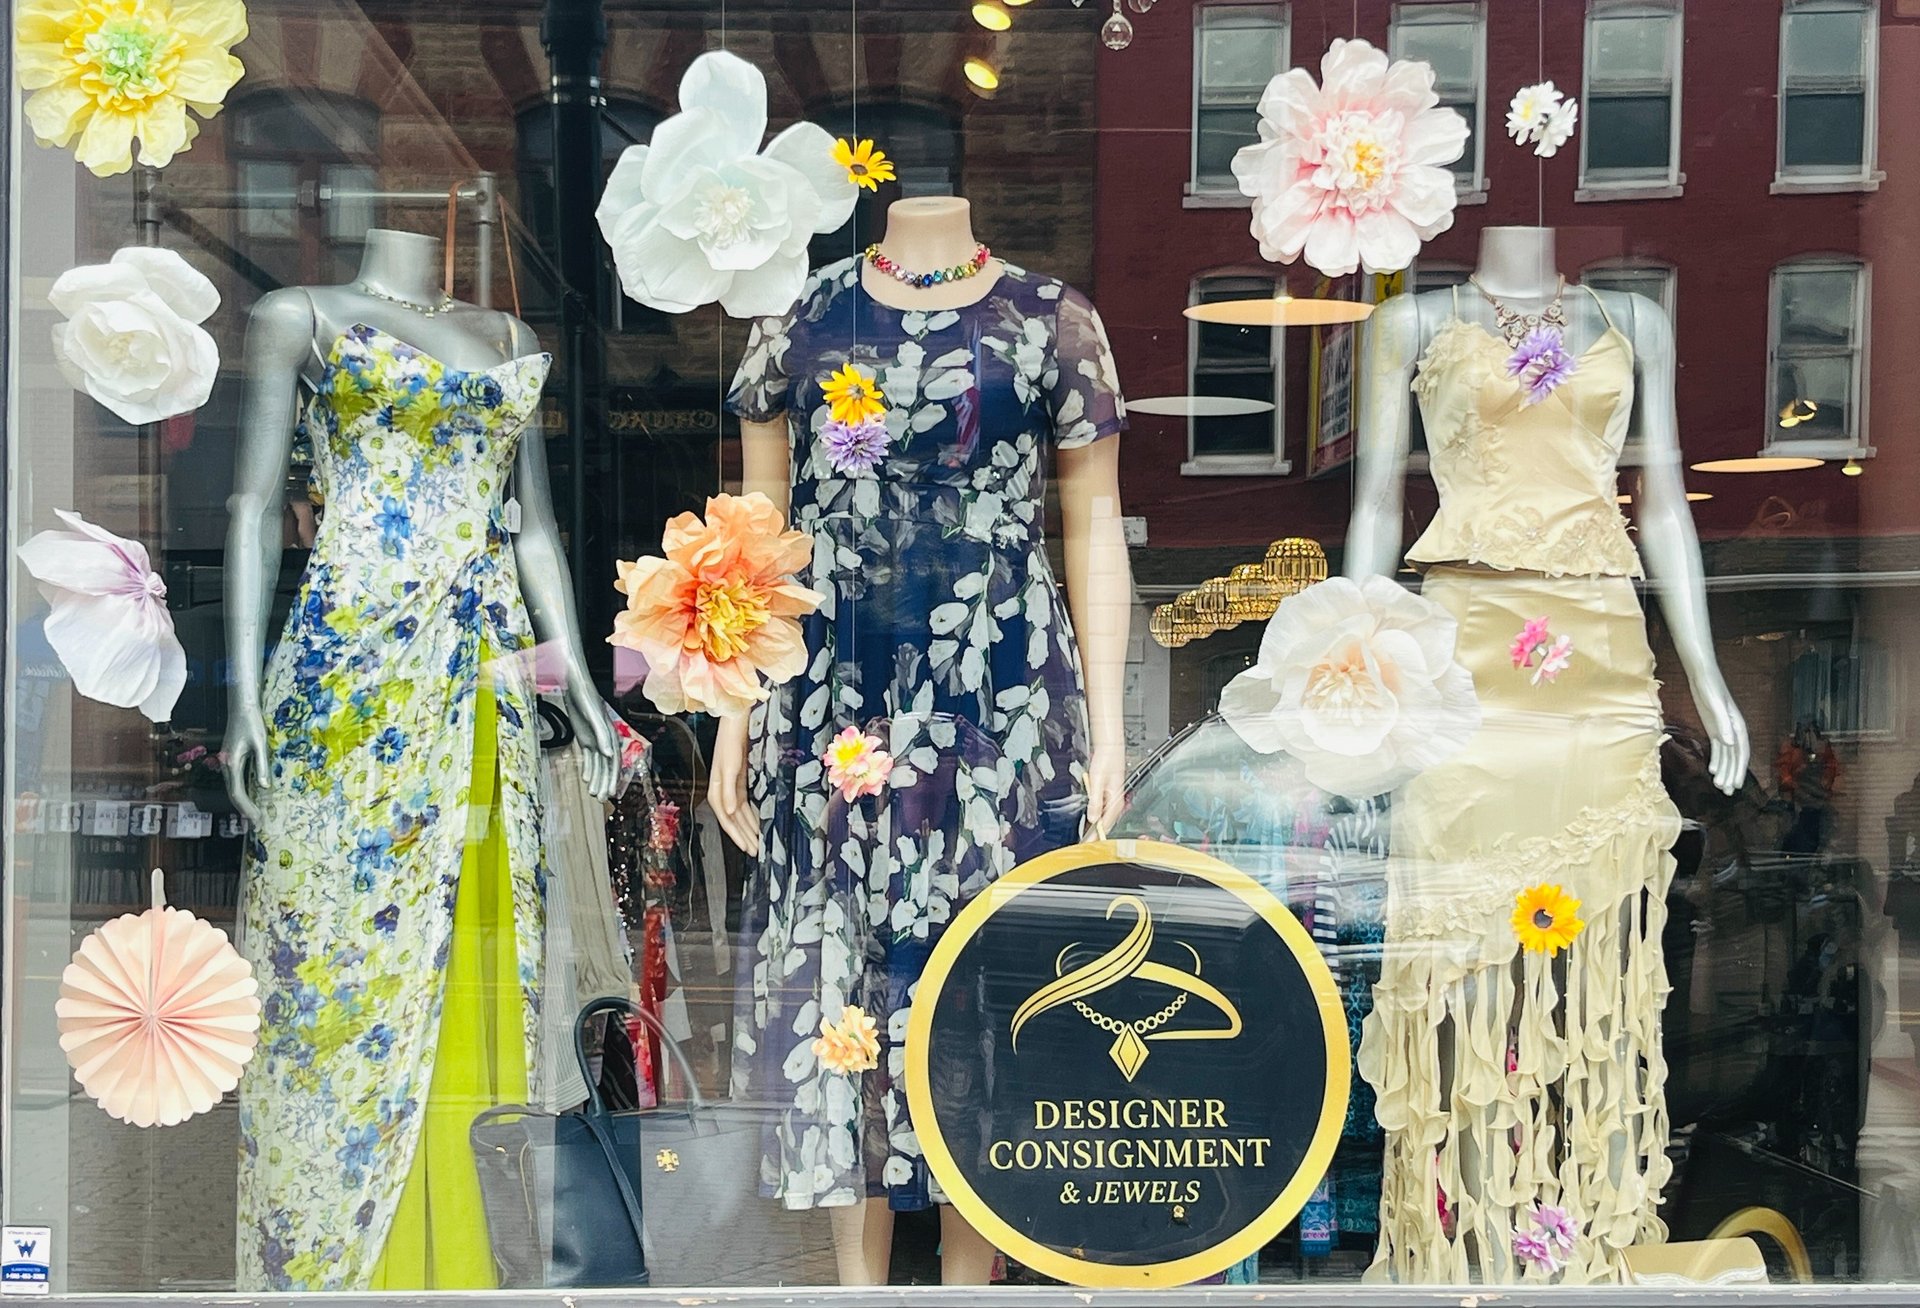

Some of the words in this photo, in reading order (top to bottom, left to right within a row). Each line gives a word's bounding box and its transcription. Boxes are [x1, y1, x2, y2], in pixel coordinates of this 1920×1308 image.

[1034, 1099, 1228, 1130] DESIGNER
[988, 1138, 1271, 1171] CONSIGNMENT
[1059, 1181, 1080, 1204] &
[1087, 1180, 1201, 1204] JEWELS
